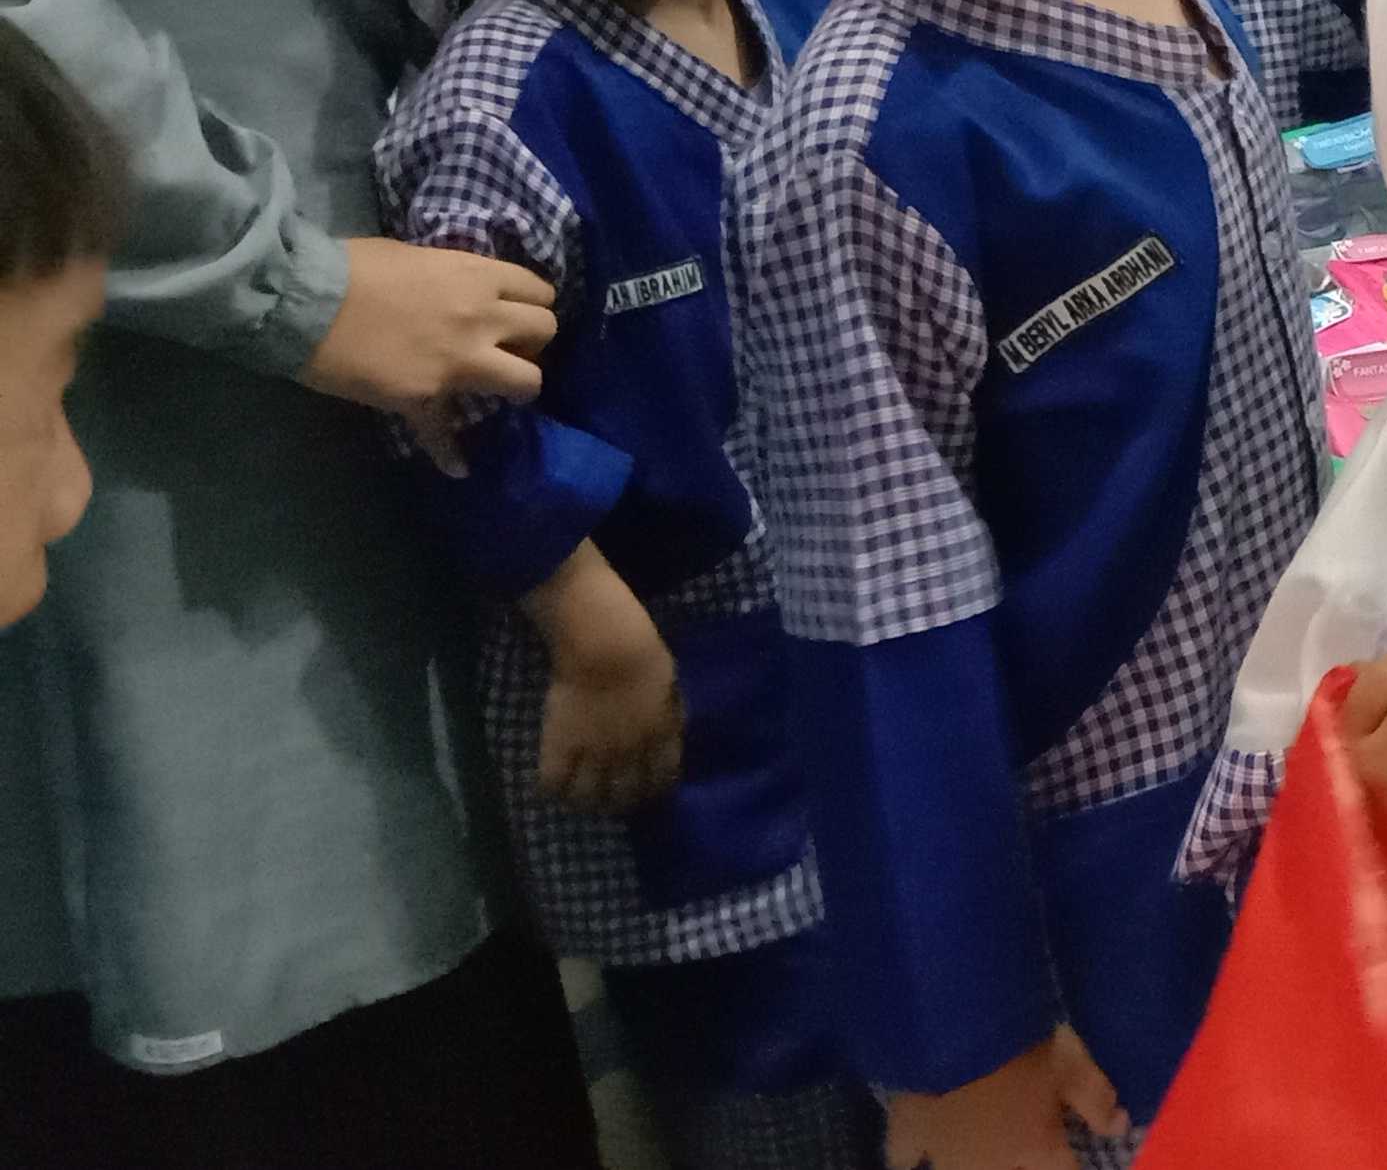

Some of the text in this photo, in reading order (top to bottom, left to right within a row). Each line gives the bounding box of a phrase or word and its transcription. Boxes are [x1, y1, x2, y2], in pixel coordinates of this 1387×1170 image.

[633, 264, 700, 305] IBRAHIM
[1016, 312, 1071, 357] BERYL
[1062, 283, 1111, 326] ARKA
[1099, 240, 1172, 302] ARDHANI
